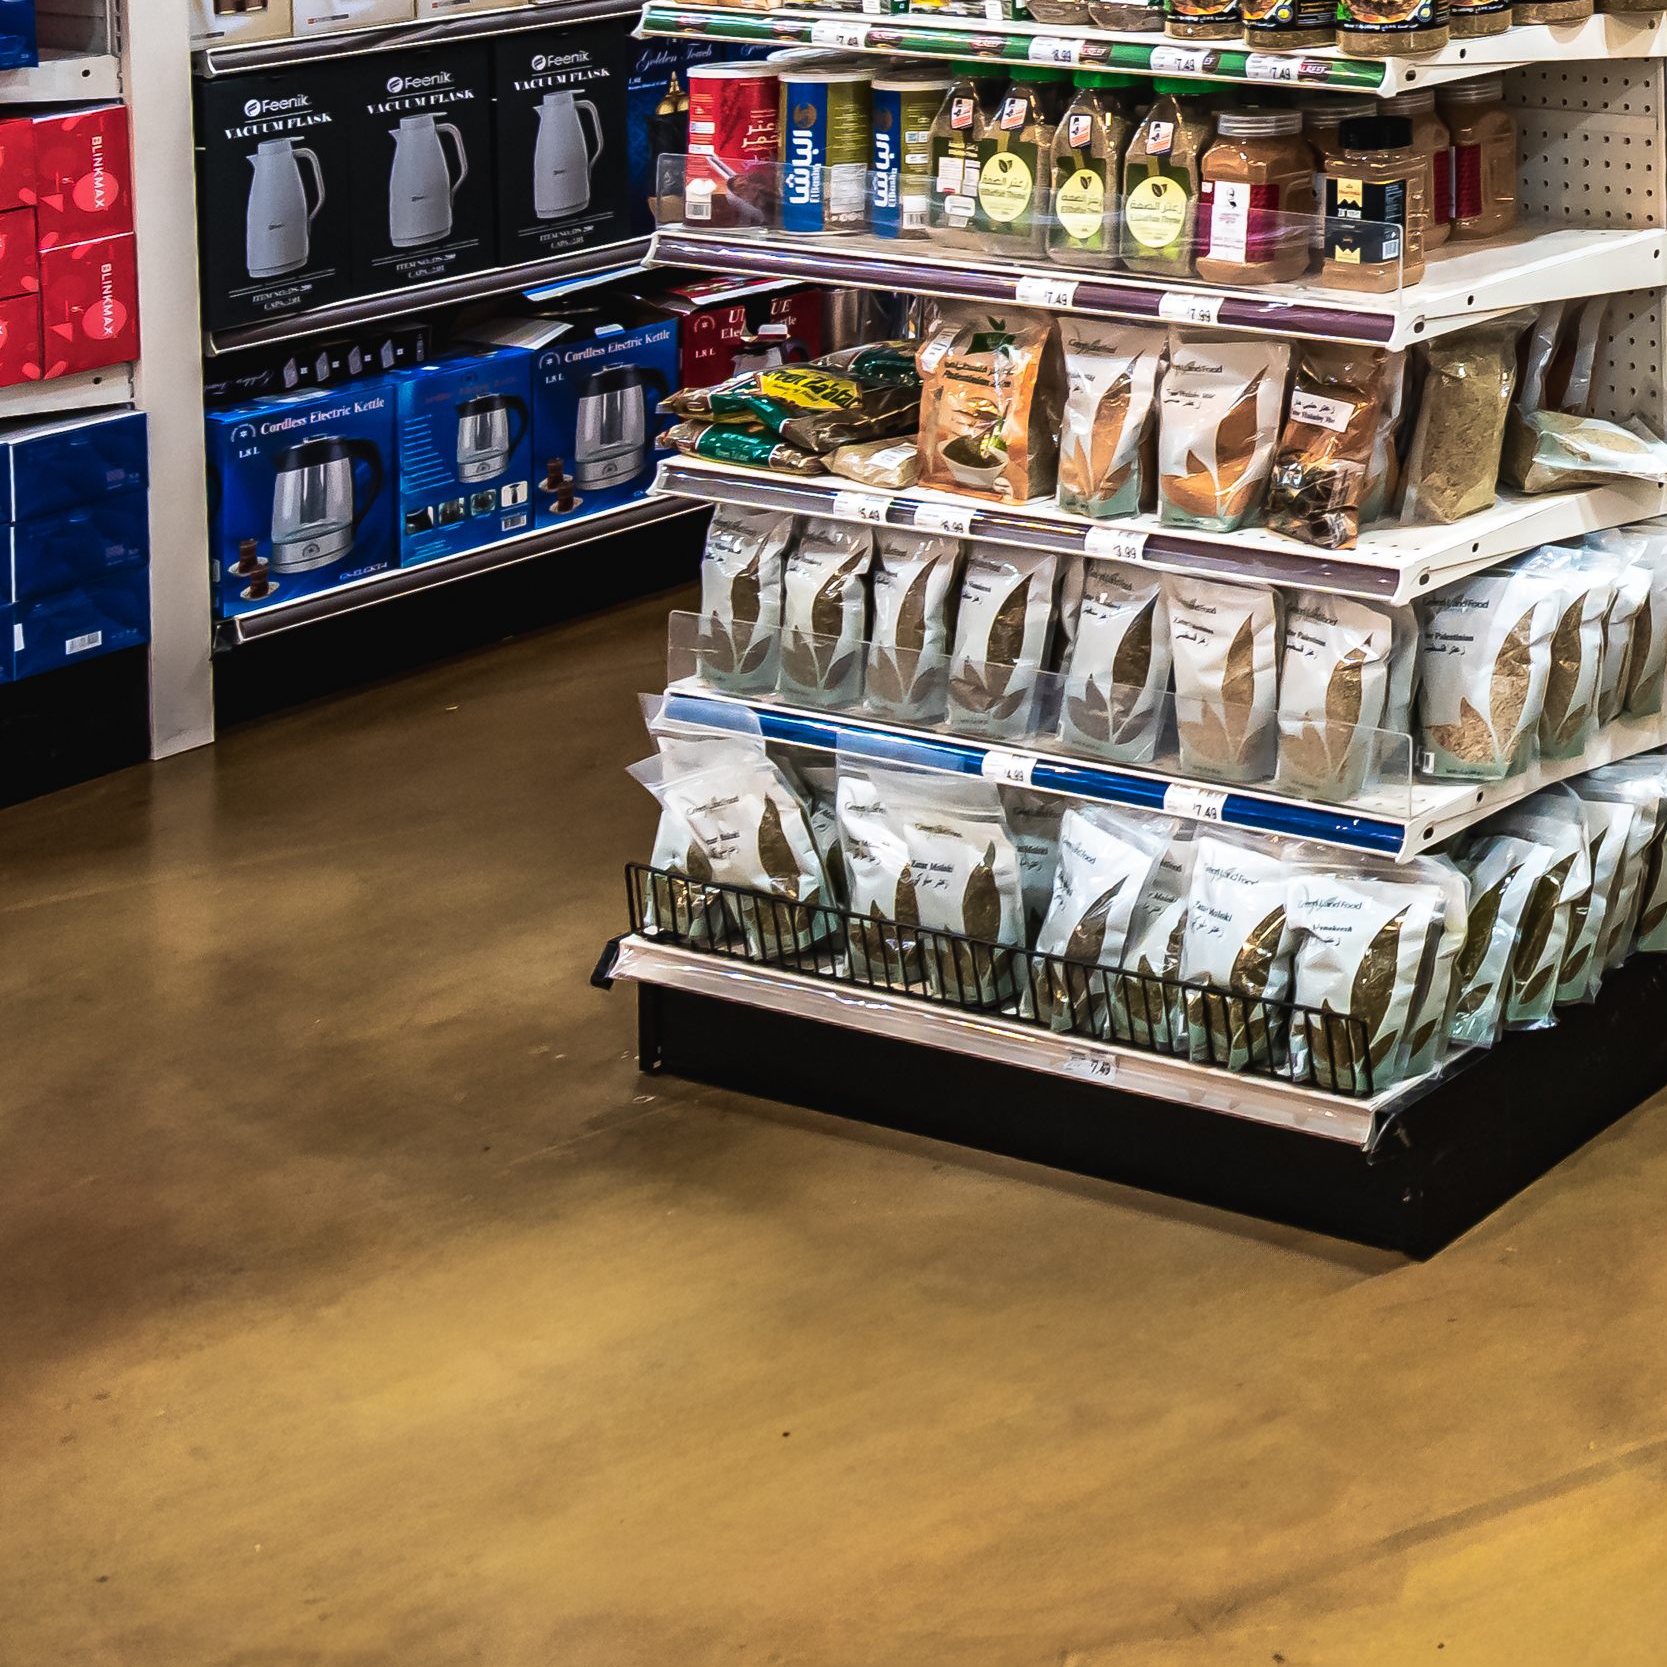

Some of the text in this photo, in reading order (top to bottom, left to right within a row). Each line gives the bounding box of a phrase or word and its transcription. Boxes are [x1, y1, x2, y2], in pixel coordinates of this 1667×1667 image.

[547, 50, 590, 66] Feenik
[636, 52, 677, 70] Golden
[404, 72, 453, 88] Feenik
[514, 67, 610, 91] VACUUM FLASK
[262, 94, 311, 112] Feenik
[367, 89, 475, 115] VACUUM FLASK
[225, 111, 332, 139] VACUUM FLASK
[92, 135, 104, 208] BLINKMAX
[101, 263, 112, 337] BLINKMAX
[564, 330, 670, 363] Cordless Electric Kettle
[260, 397, 384, 436] Cordless Electric Kettle
